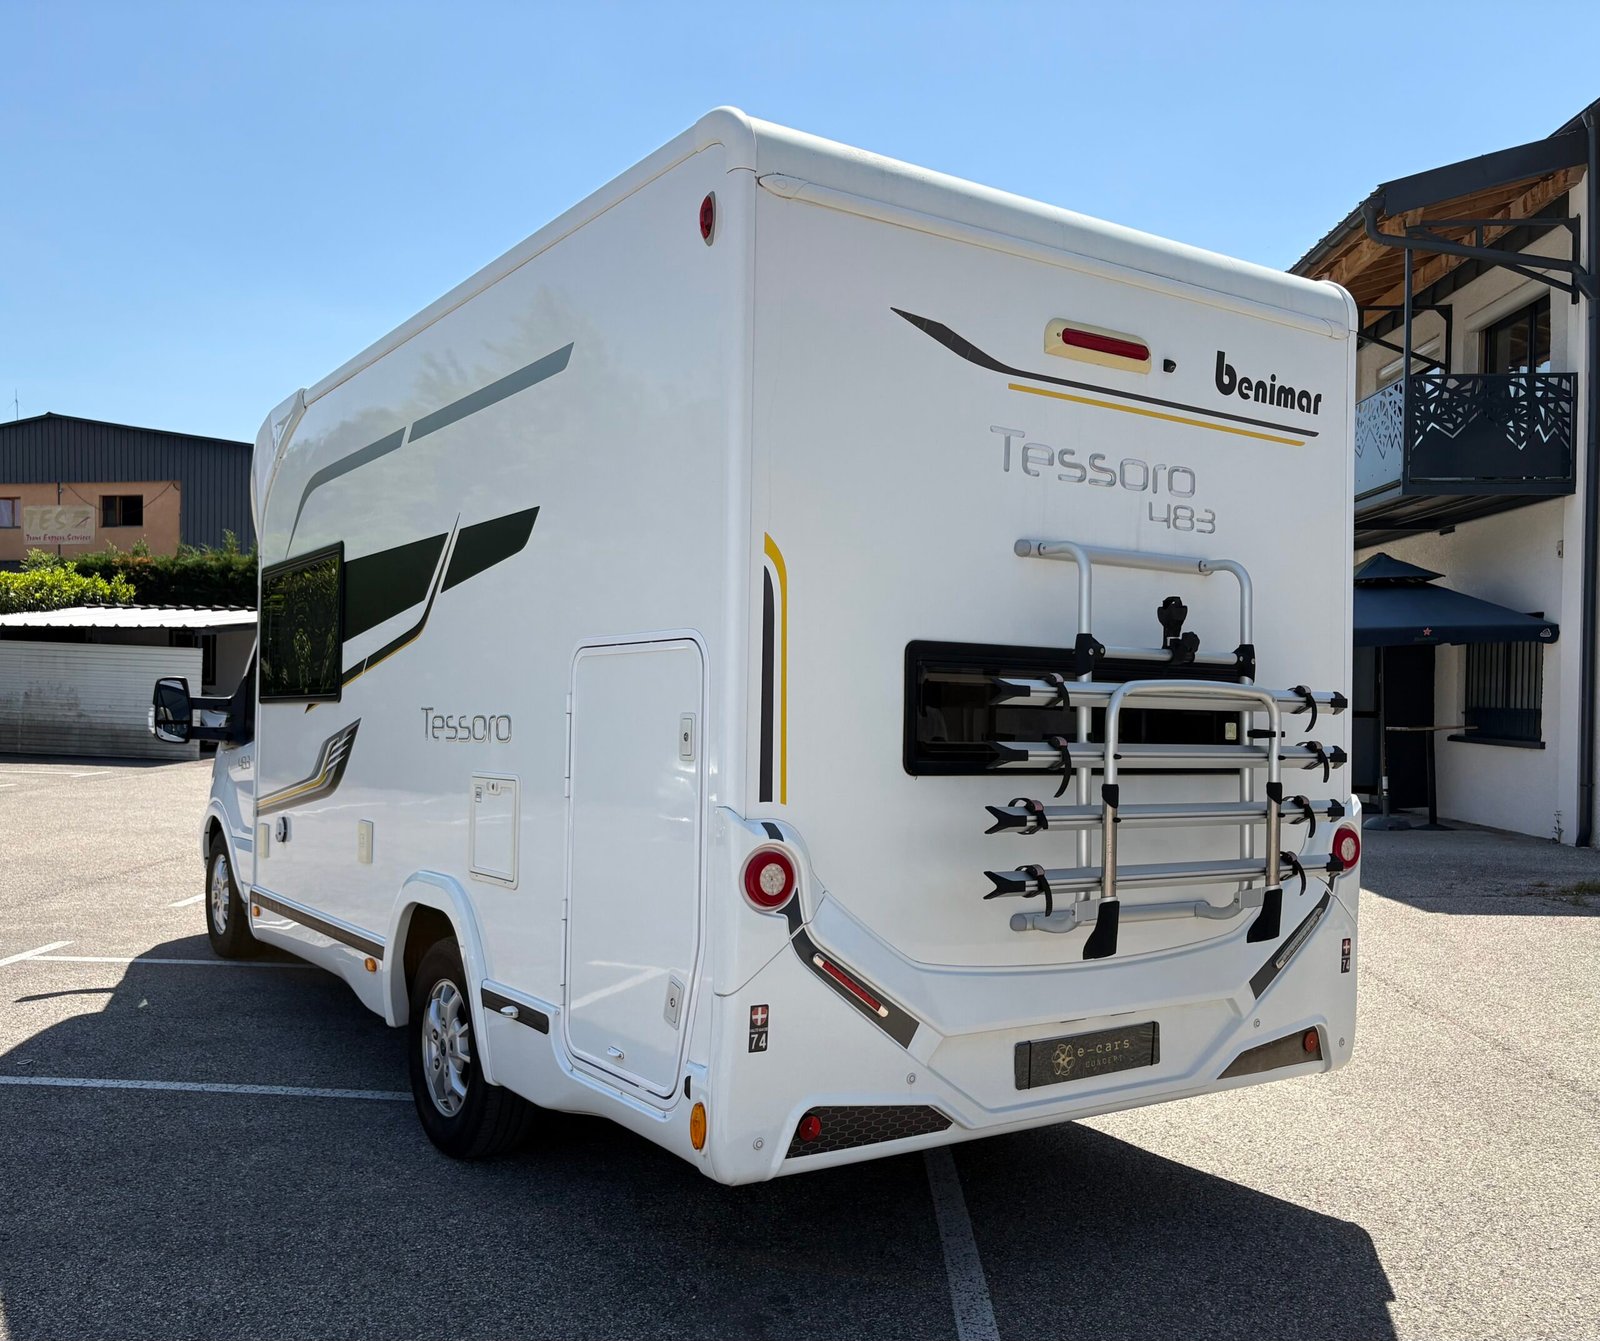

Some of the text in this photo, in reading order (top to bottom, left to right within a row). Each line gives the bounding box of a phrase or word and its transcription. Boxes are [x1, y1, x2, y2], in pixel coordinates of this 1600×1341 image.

[1215, 350, 1322, 416] benimar
[989, 424, 1197, 499] Tessoro
[1148, 501, 1217, 535] 483
[420, 706, 512, 744] Tessoro
[750, 1032, 767, 1050] 74
[1077, 1039, 1131, 1057] e-cars
